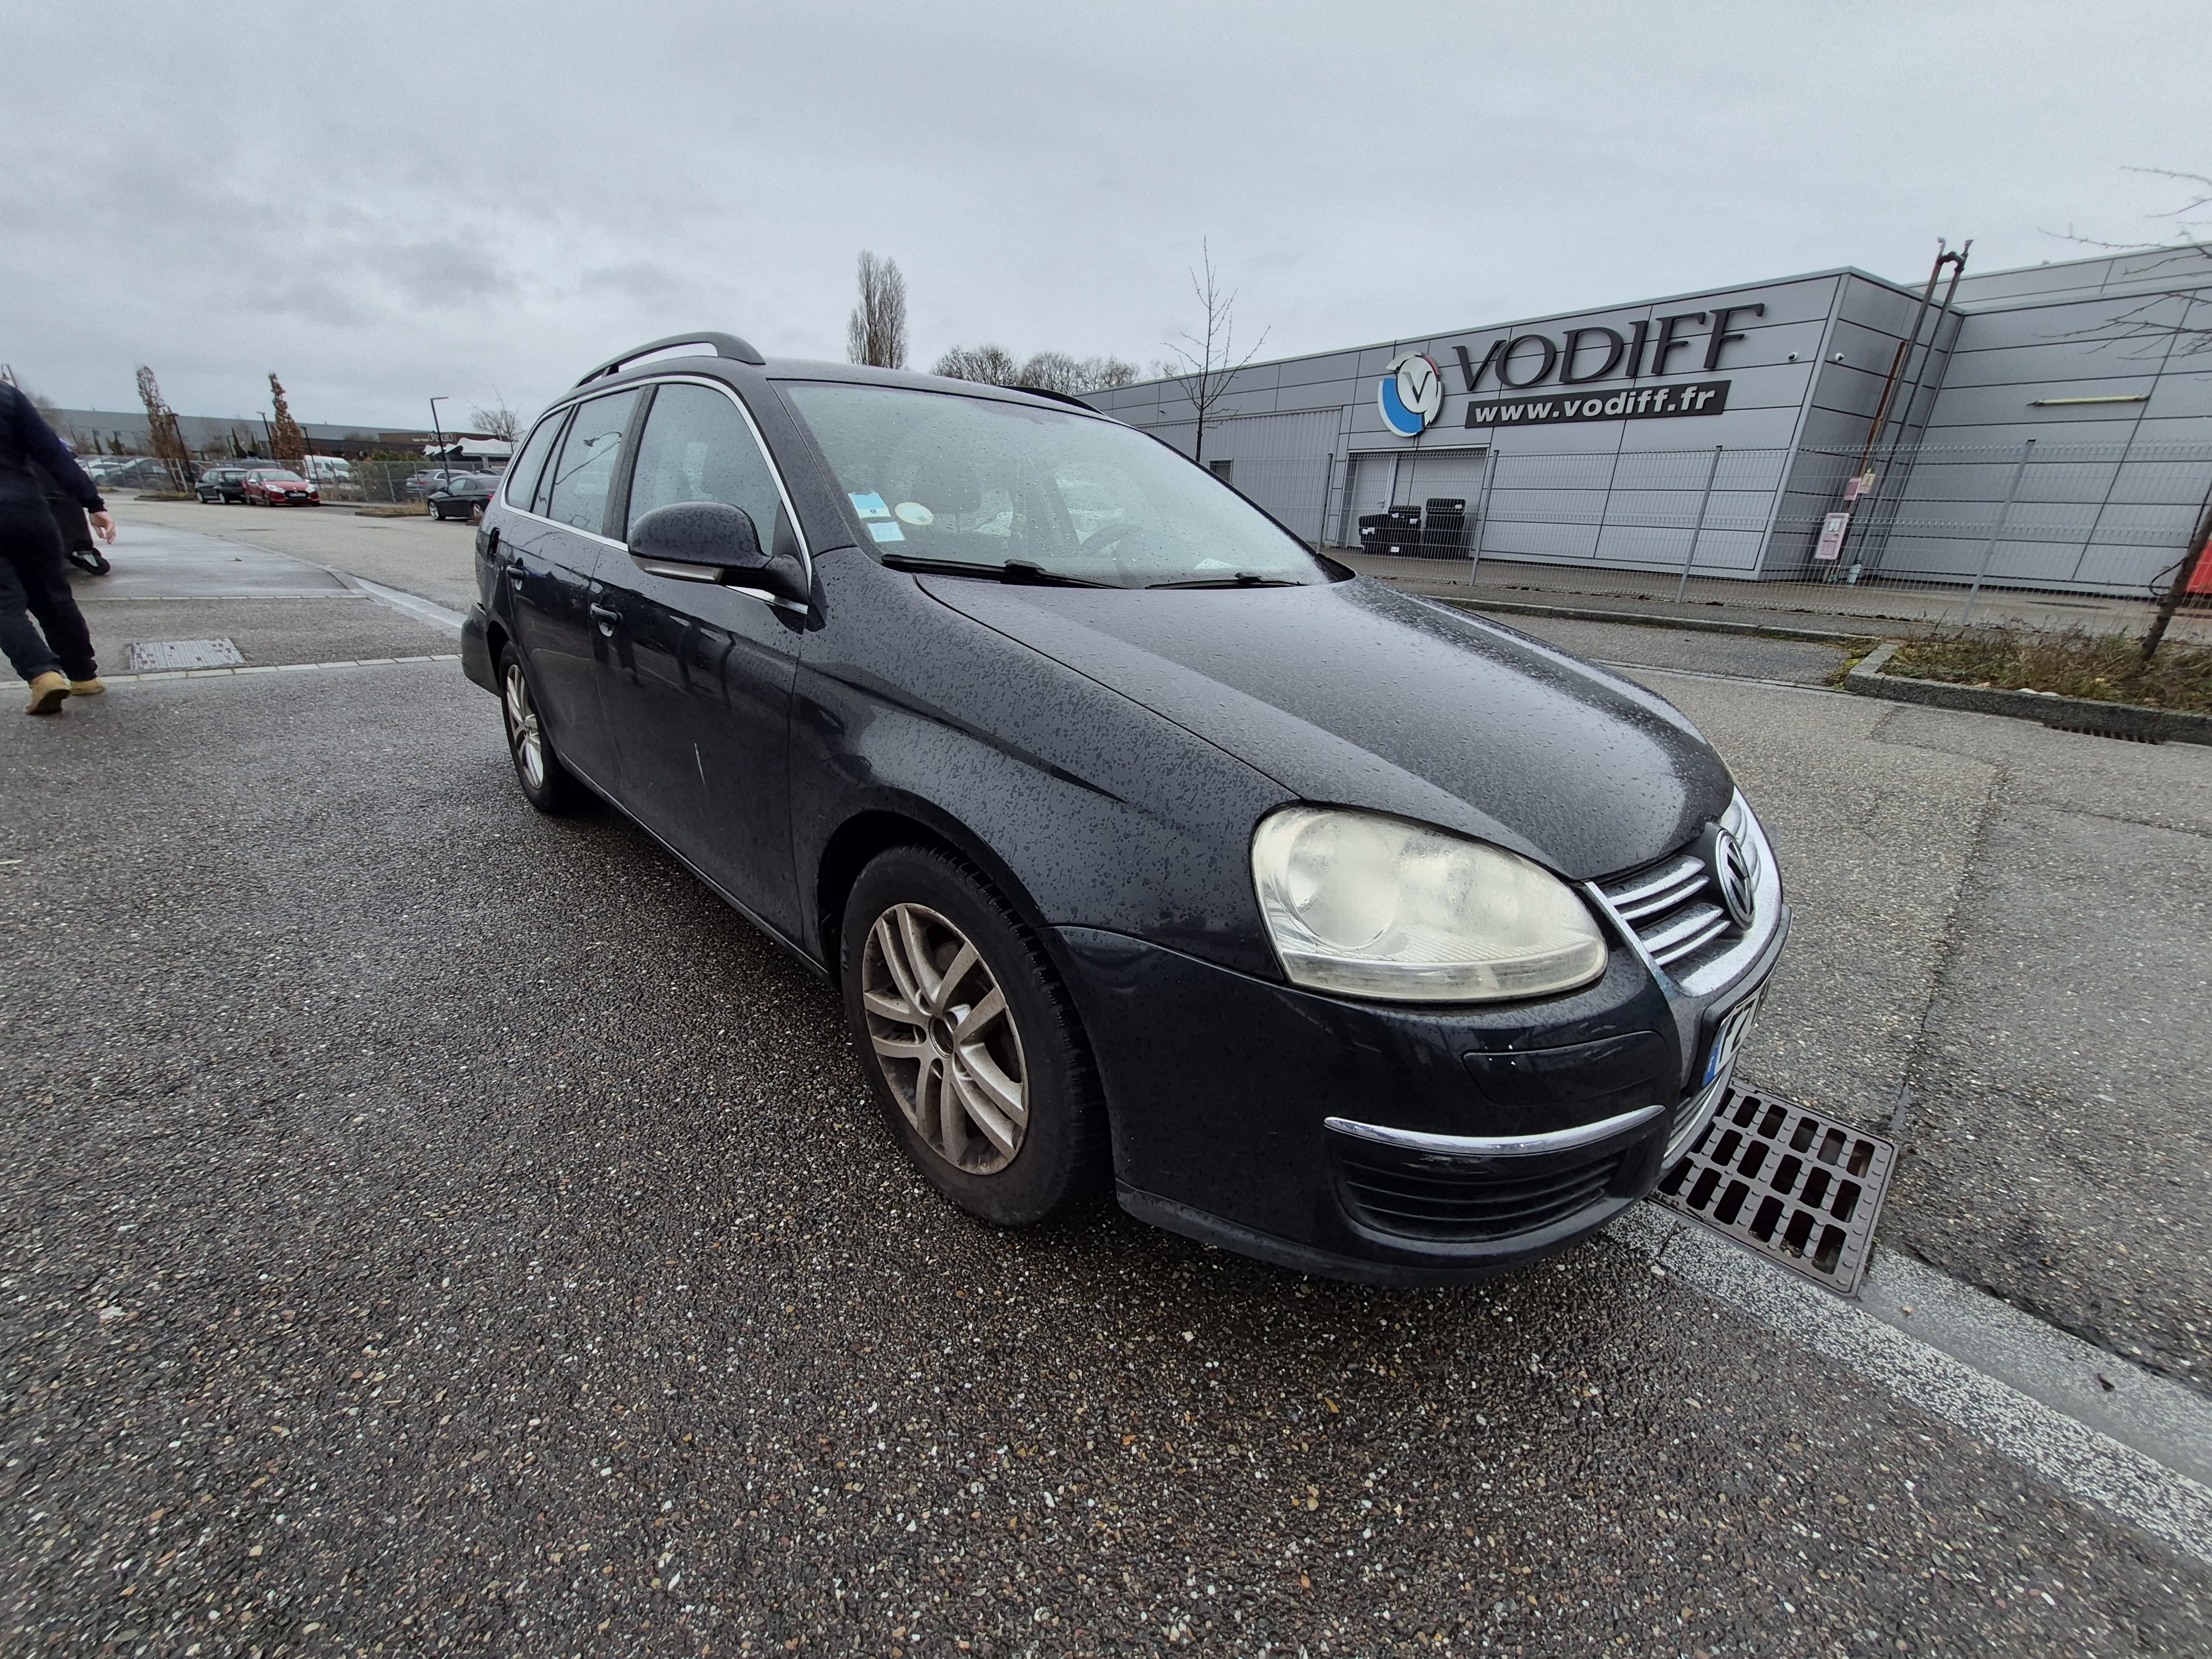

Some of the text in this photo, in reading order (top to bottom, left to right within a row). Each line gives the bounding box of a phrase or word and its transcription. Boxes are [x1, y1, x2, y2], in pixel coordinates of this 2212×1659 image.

[1452, 302, 1765, 392] VODIFF
[1402, 371, 1432, 404] V
[1475, 387, 1715, 423] www.vodiff.fr
